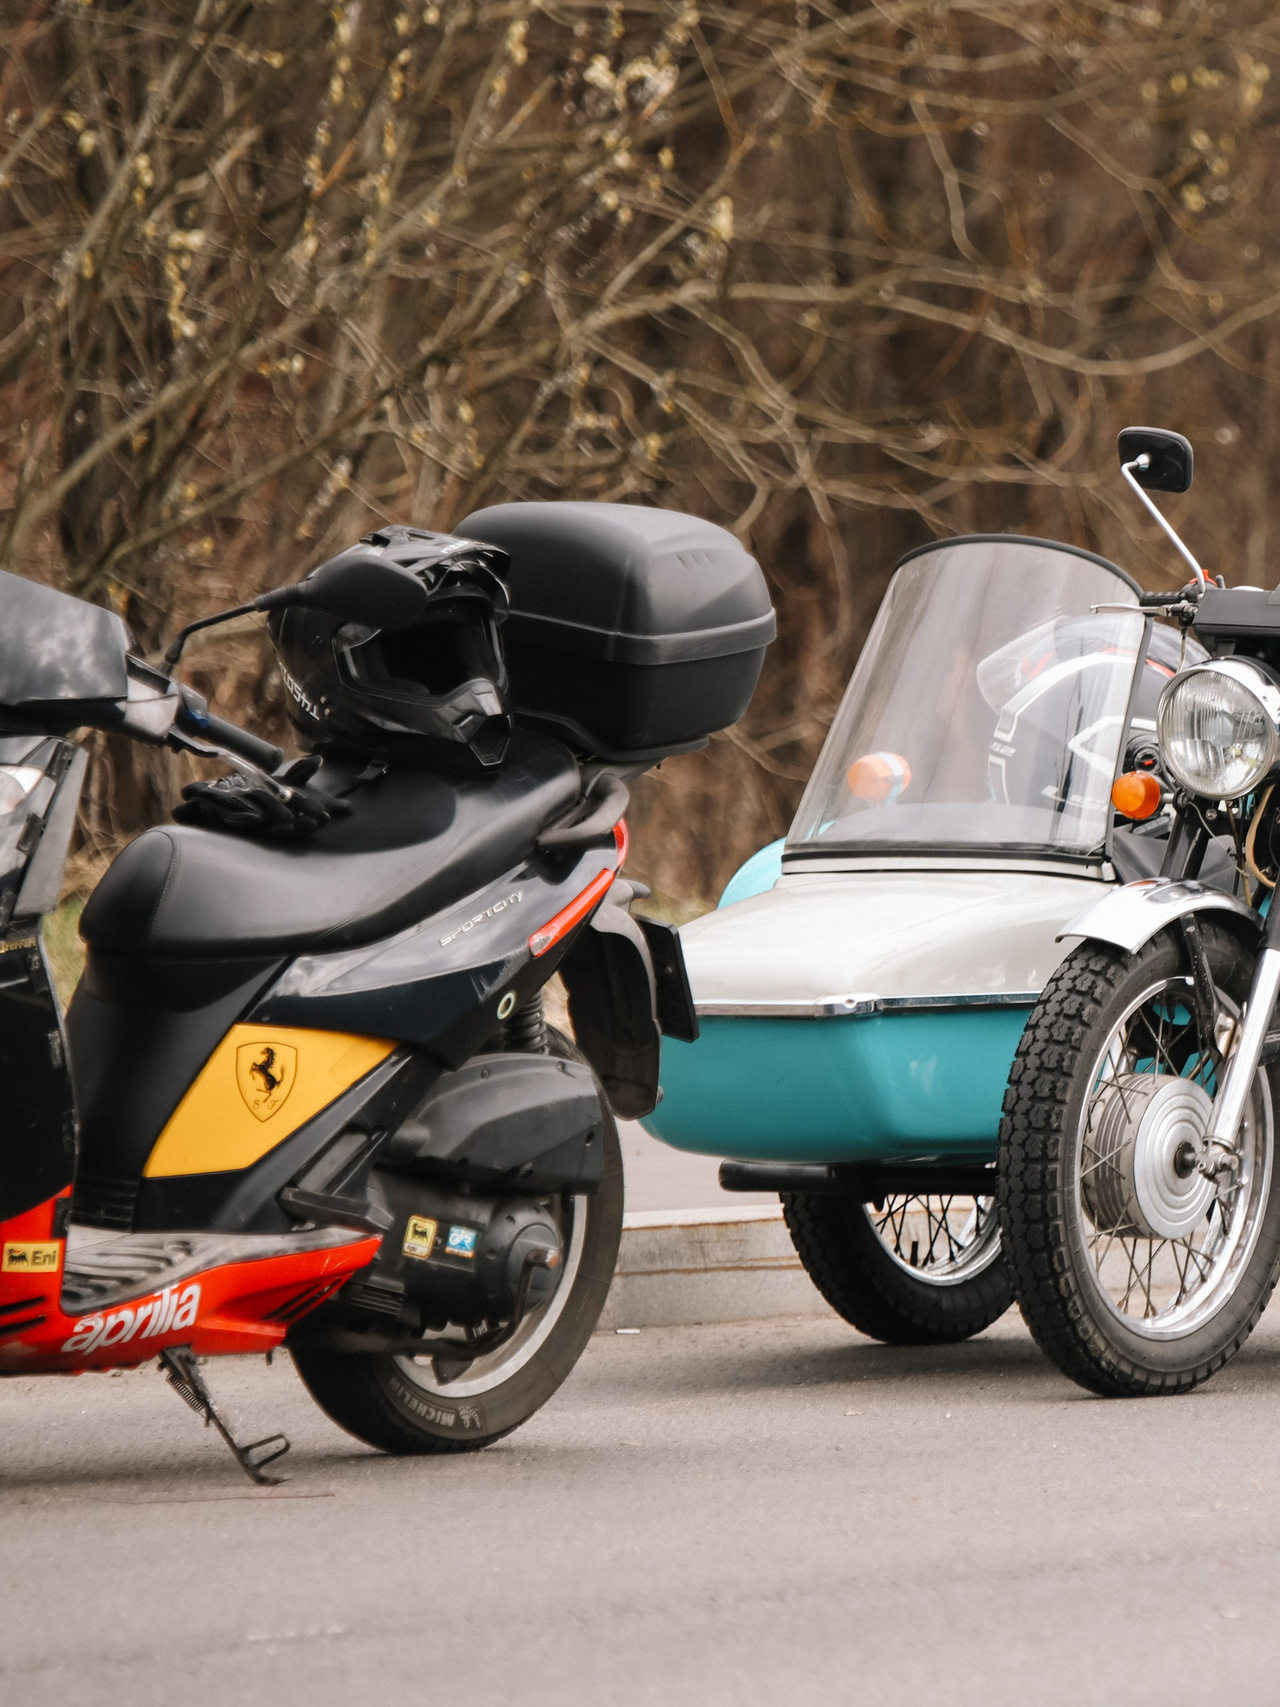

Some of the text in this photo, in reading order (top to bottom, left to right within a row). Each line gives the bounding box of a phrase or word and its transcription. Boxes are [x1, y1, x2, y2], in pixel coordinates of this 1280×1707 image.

[30, 1250, 57, 1266] Eni
[60, 1283, 202, 1356] aprilia
[388, 1376, 456, 1427] MICHELIN
